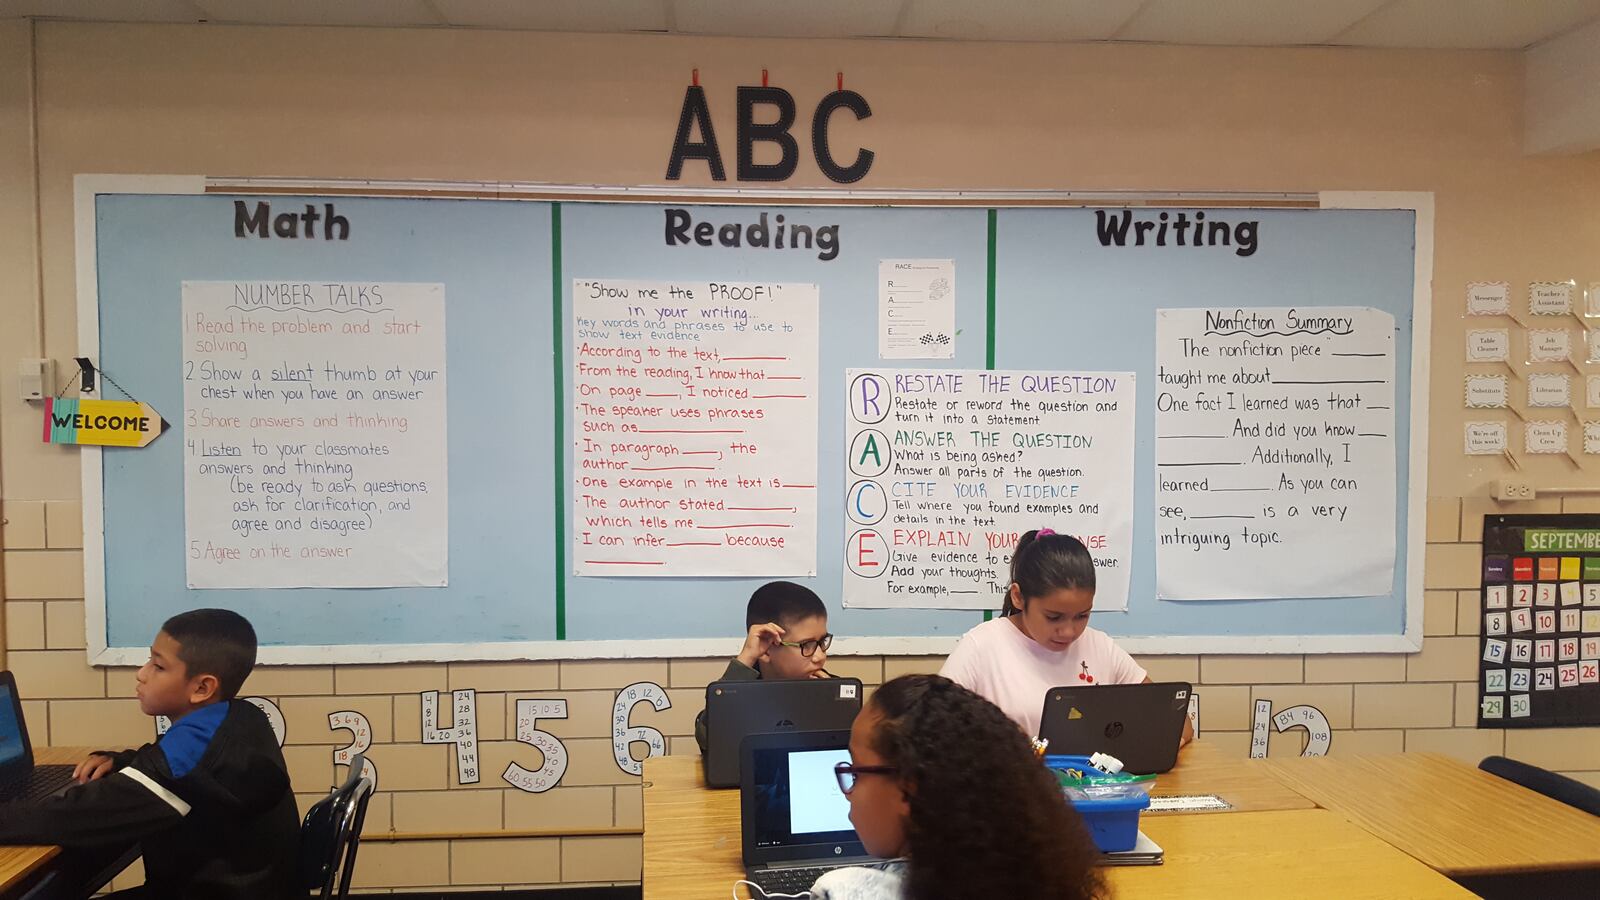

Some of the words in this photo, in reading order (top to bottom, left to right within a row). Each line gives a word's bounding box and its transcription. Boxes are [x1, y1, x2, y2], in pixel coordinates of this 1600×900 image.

[234, 201, 349, 240] Math
[664, 209, 839, 261] Reading
[1094, 210, 1259, 256] Writing
[235, 284, 315, 305] NUMBER
[323, 285, 383, 306] TALKS
[638, 289, 658, 299] me
[669, 285, 694, 299] the
[628, 306, 645, 316] in
[655, 307, 688, 320] your
[1206, 309, 1275, 331] Nonfiction
[1286, 309, 1353, 333] Summary
[580, 343, 641, 363] According
[647, 347, 660, 357] to
[668, 347, 687, 358] the
[1179, 338, 1209, 357] The
[1219, 340, 1283, 356] nonfiction
[1291, 345, 1320, 361] piece
[185, 361, 194, 381] 2
[200, 360, 242, 381] Show
[252, 370, 261, 381] a
[271, 361, 314, 381] silent
[324, 361, 376, 381] thumb
[385, 364, 402, 381] at
[409, 370, 438, 385] your
[896, 374, 963, 393] RESTATE
[979, 374, 1010, 392] THE
[1022, 376, 1116, 393] QUESTION
[201, 383, 237, 400] chest
[244, 383, 274, 400] when
[281, 389, 303, 404] you
[310, 384, 337, 400] have
[347, 389, 363, 400] an
[372, 389, 423, 400] answer
[862, 377, 880, 416] R
[581, 404, 606, 416] The
[613, 407, 663, 420] speaker
[671, 408, 700, 418] uses
[708, 407, 764, 422] phrases
[52, 413, 149, 431] WELCOME
[1233, 418, 1260, 437] And
[1265, 422, 1286, 436] did
[1294, 426, 1316, 439] you
[1325, 421, 1355, 436] know
[895, 430, 955, 447] ANSWER
[970, 431, 1000, 447] THE
[1013, 433, 1092, 448] QUESTION
[860, 434, 881, 467] A
[1342, 443, 1351, 463] I
[894, 450, 924, 461] What
[931, 450, 940, 461] is
[947, 451, 976, 467] being
[583, 477, 608, 488] One
[619, 478, 673, 491] example
[684, 479, 696, 488] in
[705, 478, 728, 488] the
[737, 475, 762, 488] text
[769, 478, 780, 488] is
[892, 483, 936, 496] CITE
[954, 482, 987, 498] YOUR
[1006, 484, 1079, 498] EVIDENCE
[583, 495, 607, 508] The
[619, 498, 670, 508] author
[679, 498, 724, 509] stated
[857, 484, 876, 518] C
[893, 500, 913, 510] Tell
[918, 502, 951, 510] where
[963, 504, 982, 515] you
[988, 502, 1019, 513] found
[1026, 503, 1073, 516] examples
[1079, 504, 1098, 513] and
[1263, 505, 1275, 517] is
[1288, 506, 1298, 516] a
[1312, 506, 1347, 521] very
[232, 519, 269, 536] agree
[276, 517, 301, 530] and
[586, 516, 632, 527] which
[640, 516, 667, 528] tells
[675, 518, 693, 528] me
[894, 530, 971, 547] EXPLAIN
[985, 534, 1017, 549] YOUR
[1161, 528, 1230, 551] intriguing
[859, 534, 878, 566] E
[1495, 592, 1500, 604] 1
[1519, 590, 1527, 601] 2
[1543, 589, 1549, 600] 3
[1589, 590, 1596, 601] 5
[1493, 618, 1500, 630] 8
[1518, 614, 1525, 626] 9
[1539, 616, 1551, 628] 10
[1566, 615, 1575, 626] 11
[1490, 645, 1501, 657] 15
[1516, 645, 1527, 657] 16
[1540, 645, 1551, 657] 17
[1562, 643, 1574, 655] 18
[1586, 643, 1596, 655] 19
[1561, 670, 1576, 682] 25
[1582, 666, 1596, 678] 26
[1488, 675, 1503, 687] 22
[1513, 674, 1527, 686] 23
[1538, 673, 1552, 685] 24
[458, 692, 470, 701] 24
[627, 689, 637, 700] 18
[643, 689, 652, 697] 12
[458, 705, 470, 713] 28
[528, 705, 537, 714] 15
[1257, 705, 1267, 713] 12
[1486, 701, 1500, 714] 29
[1513, 700, 1527, 712] 30
[1302, 711, 1314, 720] 96
[616, 729, 625, 737] 36
[1255, 723, 1265, 731] 24
[1253, 738, 1265, 746] 36
[1311, 732, 1327, 741] 108
[460, 741, 472, 749] 40
[464, 768, 475, 778] 48
